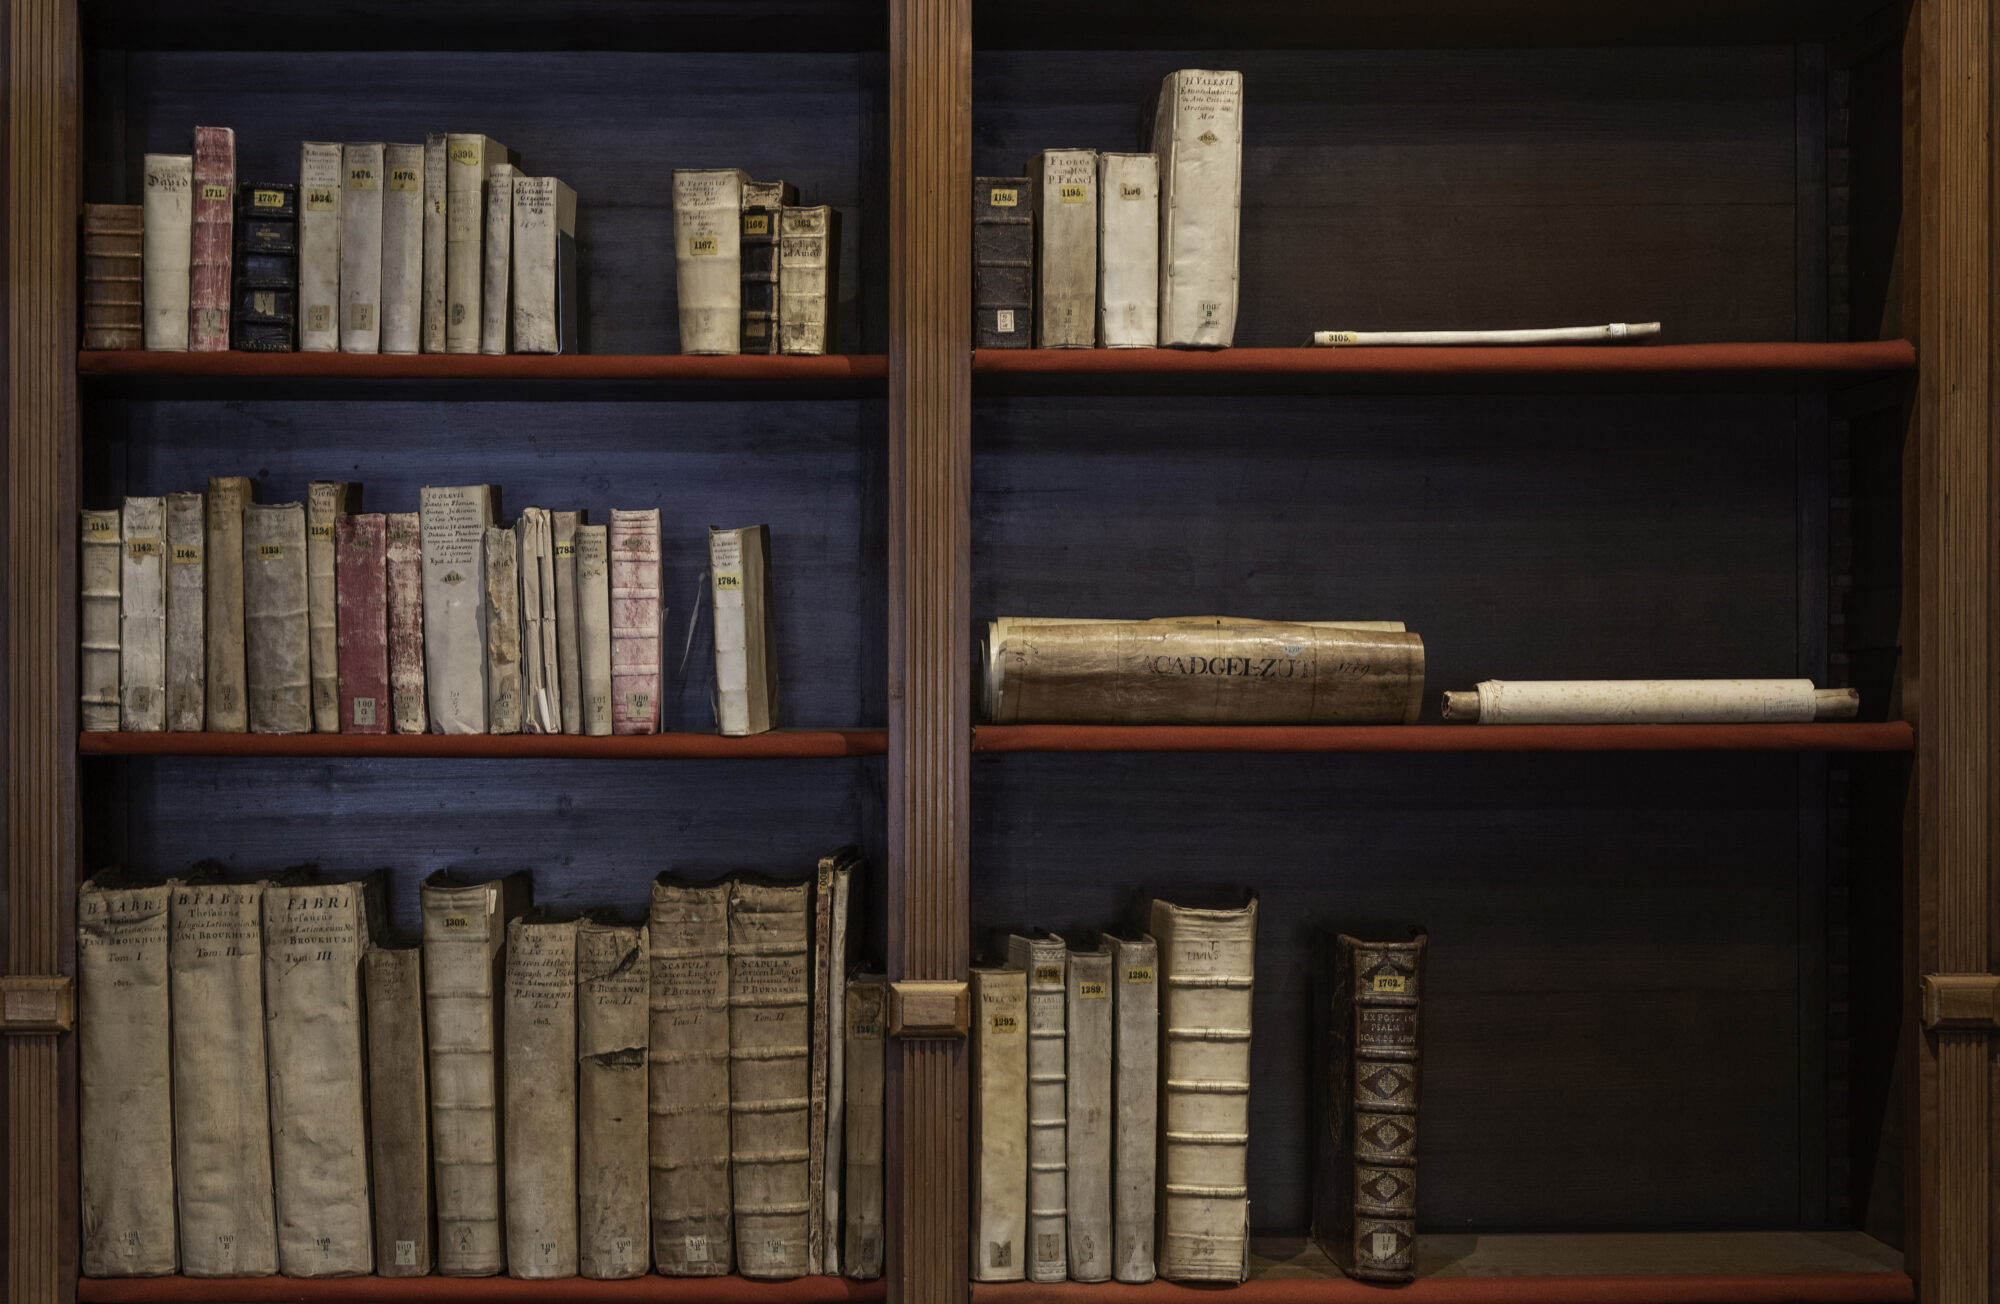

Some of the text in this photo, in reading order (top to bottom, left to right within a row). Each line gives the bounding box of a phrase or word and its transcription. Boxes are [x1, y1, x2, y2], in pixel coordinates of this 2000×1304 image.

[205, 188, 226, 198] 1711.
[694, 240, 715, 250] 1167.
[718, 576, 740, 586] 1784.
[633, 694, 649, 702] 100
[357, 699, 373, 708] 100
[287, 896, 350, 911] FABRI
[1128, 970, 1152, 980] 1290.
[1081, 985, 1104, 995] 1289.
